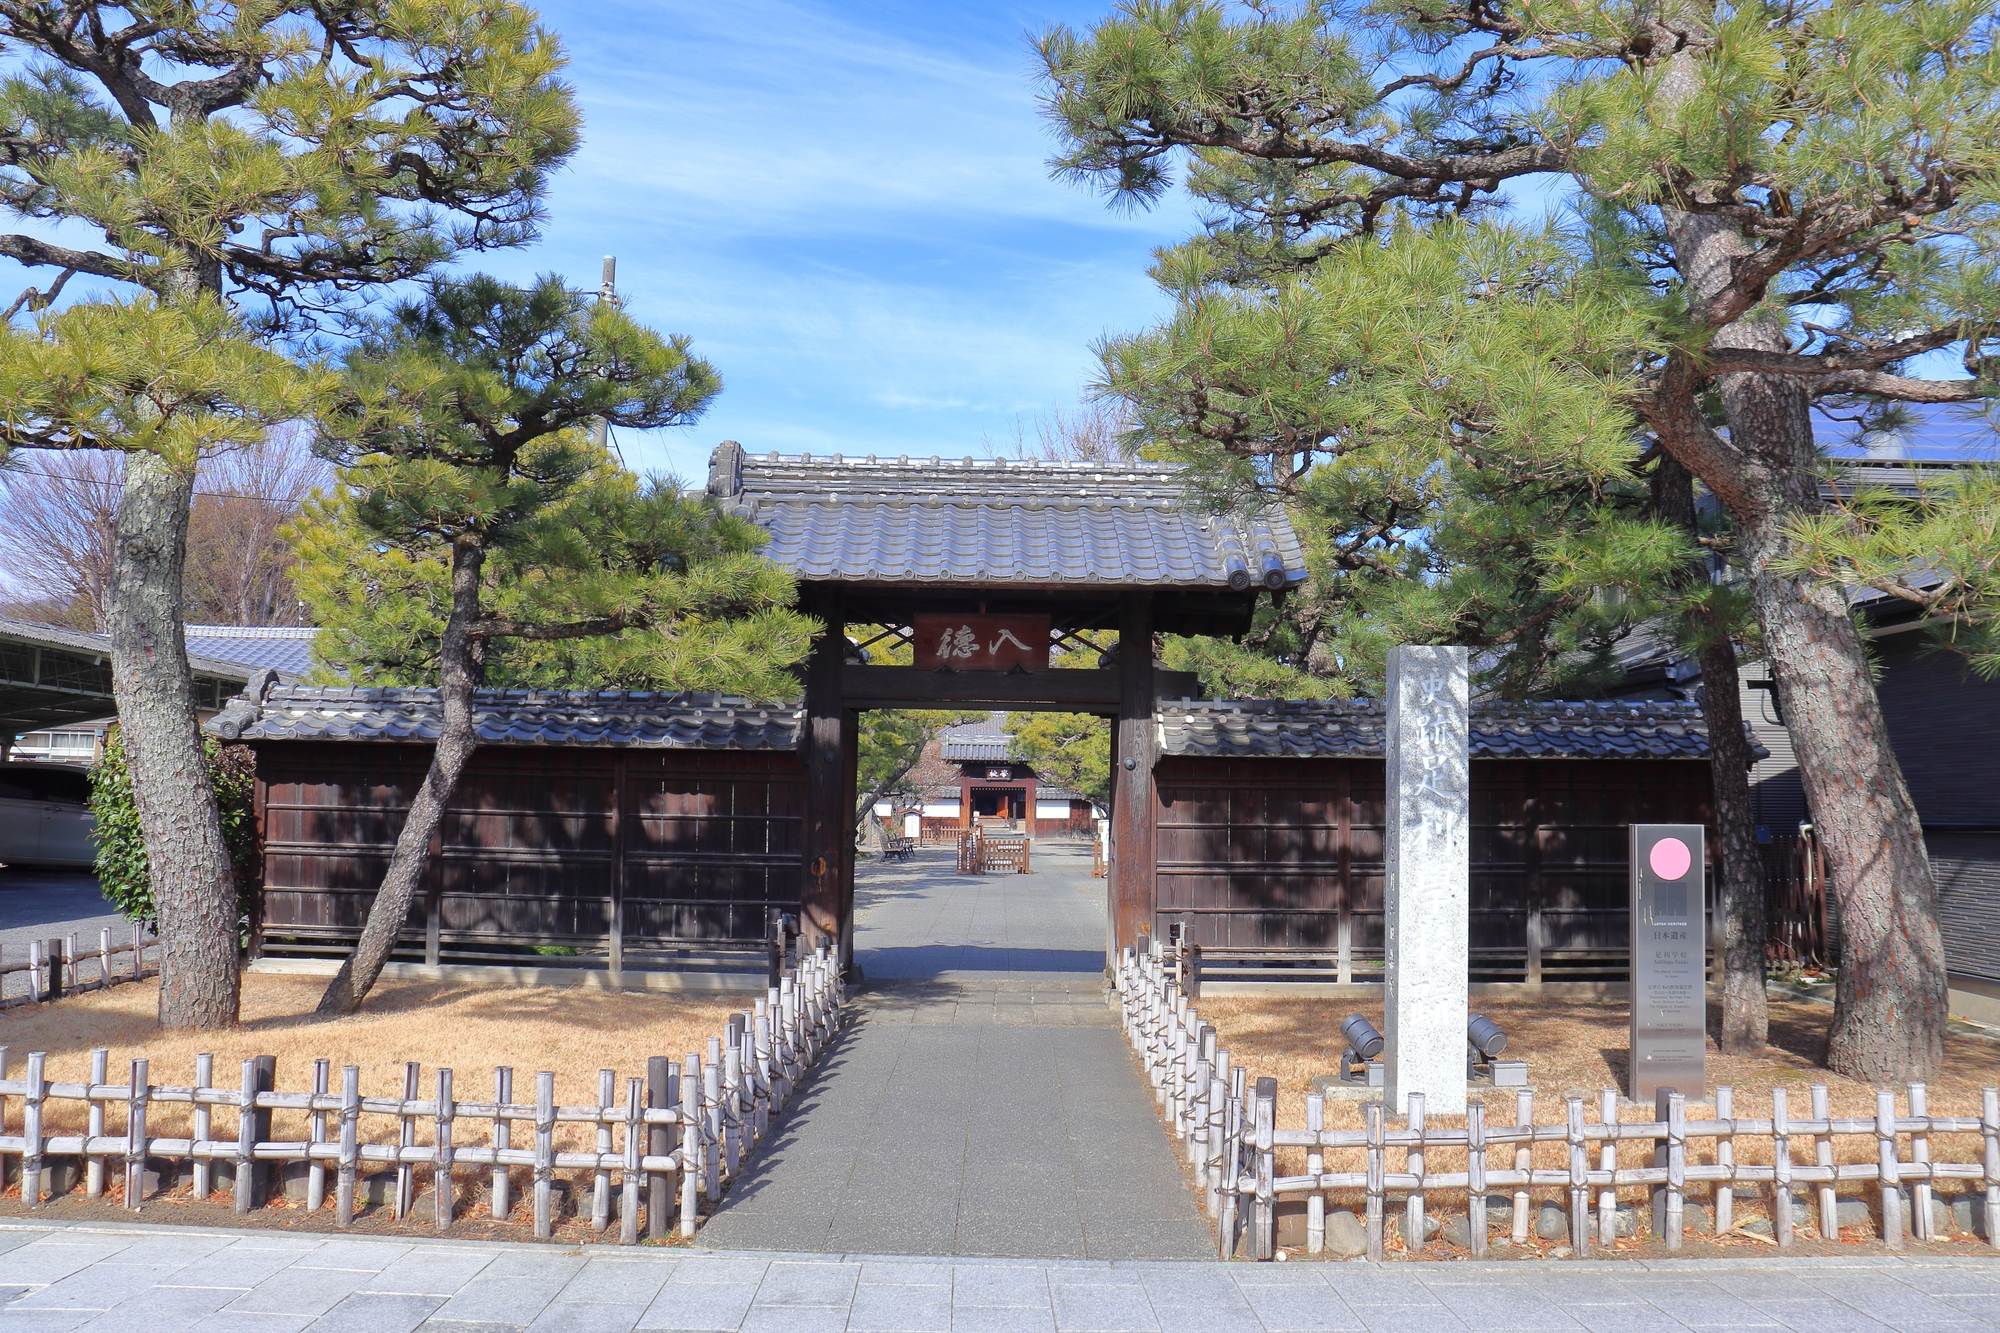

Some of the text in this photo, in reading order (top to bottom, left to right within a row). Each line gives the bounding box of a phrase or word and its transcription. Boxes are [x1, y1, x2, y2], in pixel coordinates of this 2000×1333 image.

[1654, 931, 1688, 940] 日本遺産
[1655, 951, 1688, 959] 足利学校
